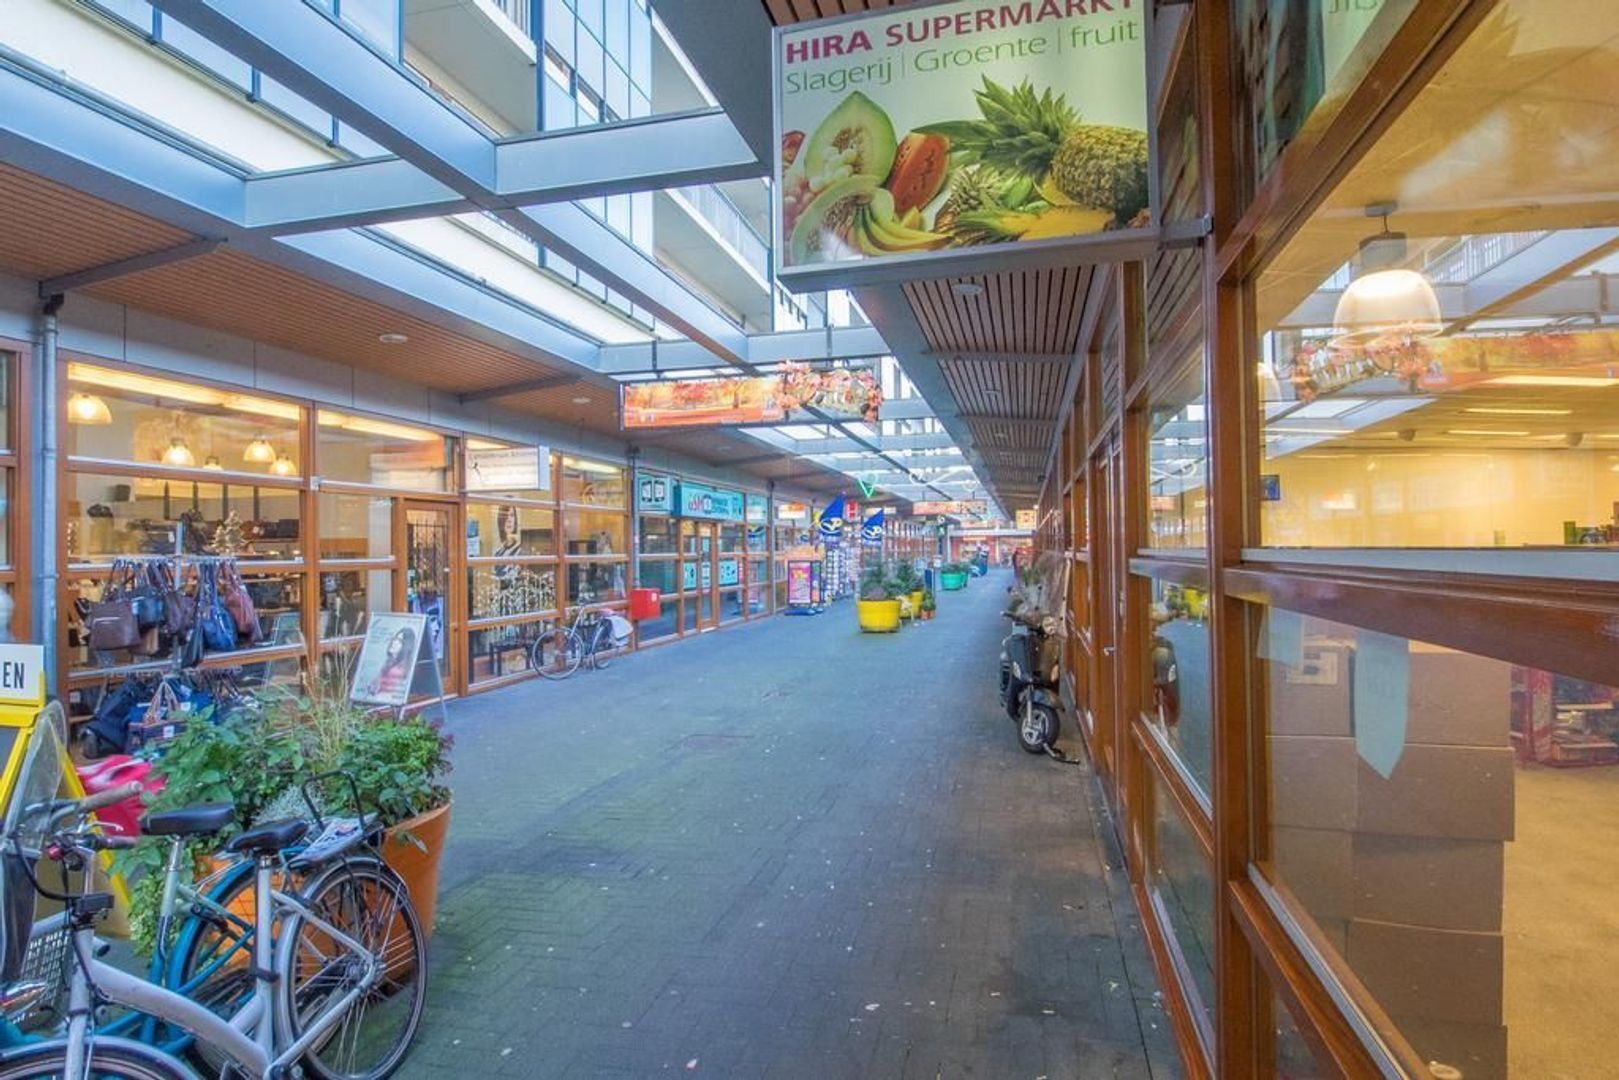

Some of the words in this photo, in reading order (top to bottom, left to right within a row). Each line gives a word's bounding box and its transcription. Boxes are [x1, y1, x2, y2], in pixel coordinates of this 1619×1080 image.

[786, 30, 873, 64] HIRA
[786, 57, 892, 94] Slagerij
[914, 35, 1047, 72] Groente
[1071, 19, 1139, 48] fruit
